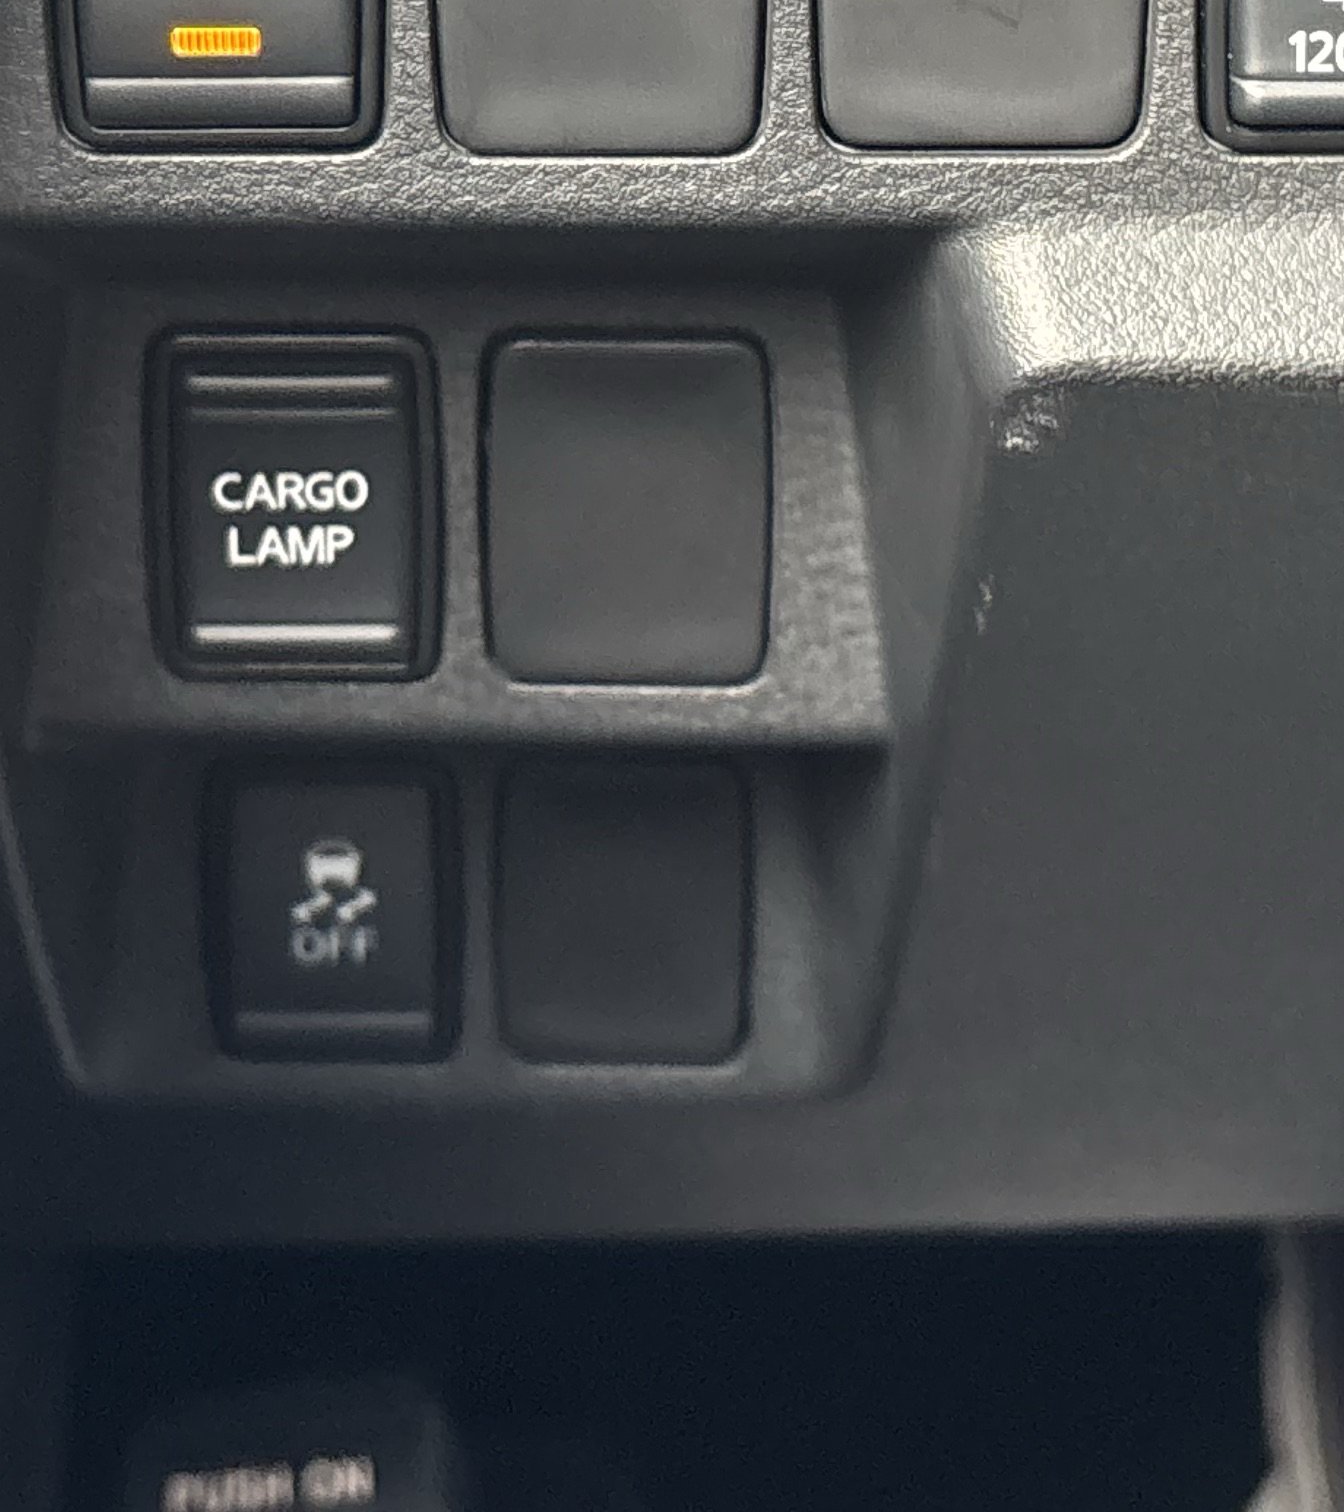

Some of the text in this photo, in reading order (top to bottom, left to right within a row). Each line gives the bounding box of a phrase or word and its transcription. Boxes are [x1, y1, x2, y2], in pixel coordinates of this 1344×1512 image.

[212, 470, 369, 512] CARGO
[227, 524, 355, 567] LAMP
[292, 926, 379, 966] OFF
